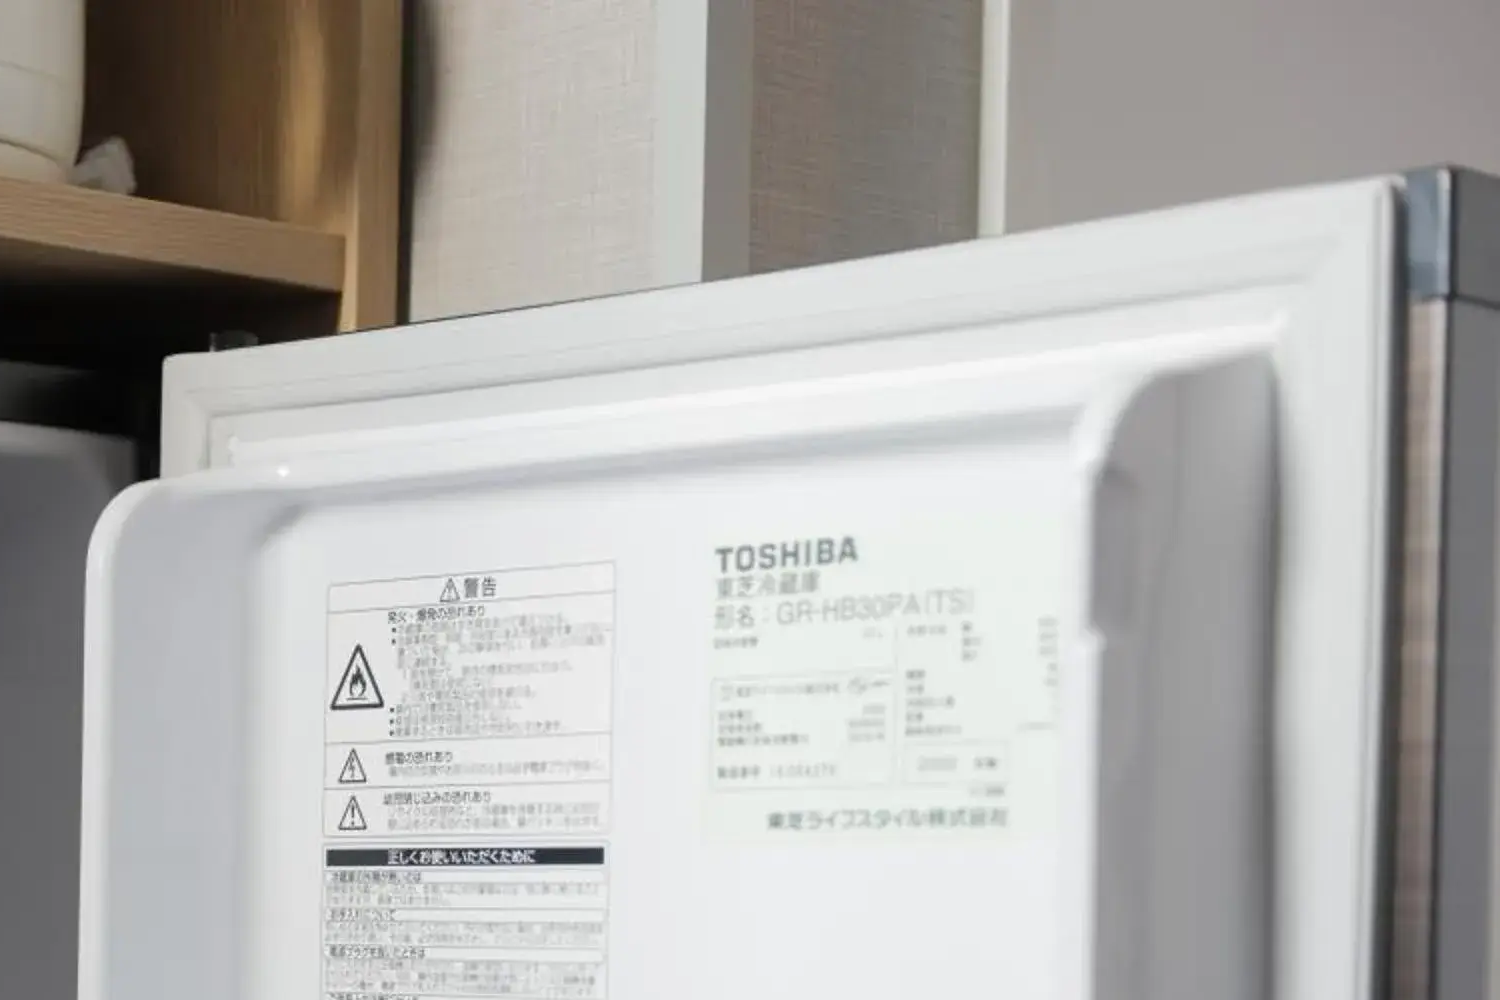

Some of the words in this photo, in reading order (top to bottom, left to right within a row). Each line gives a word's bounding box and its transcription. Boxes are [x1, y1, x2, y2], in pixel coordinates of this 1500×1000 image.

[715, 536, 858, 574] TOSHIBA
[463, 576, 497, 598] 警告
[387, 849, 536, 865] 正しくお使いいただくために
